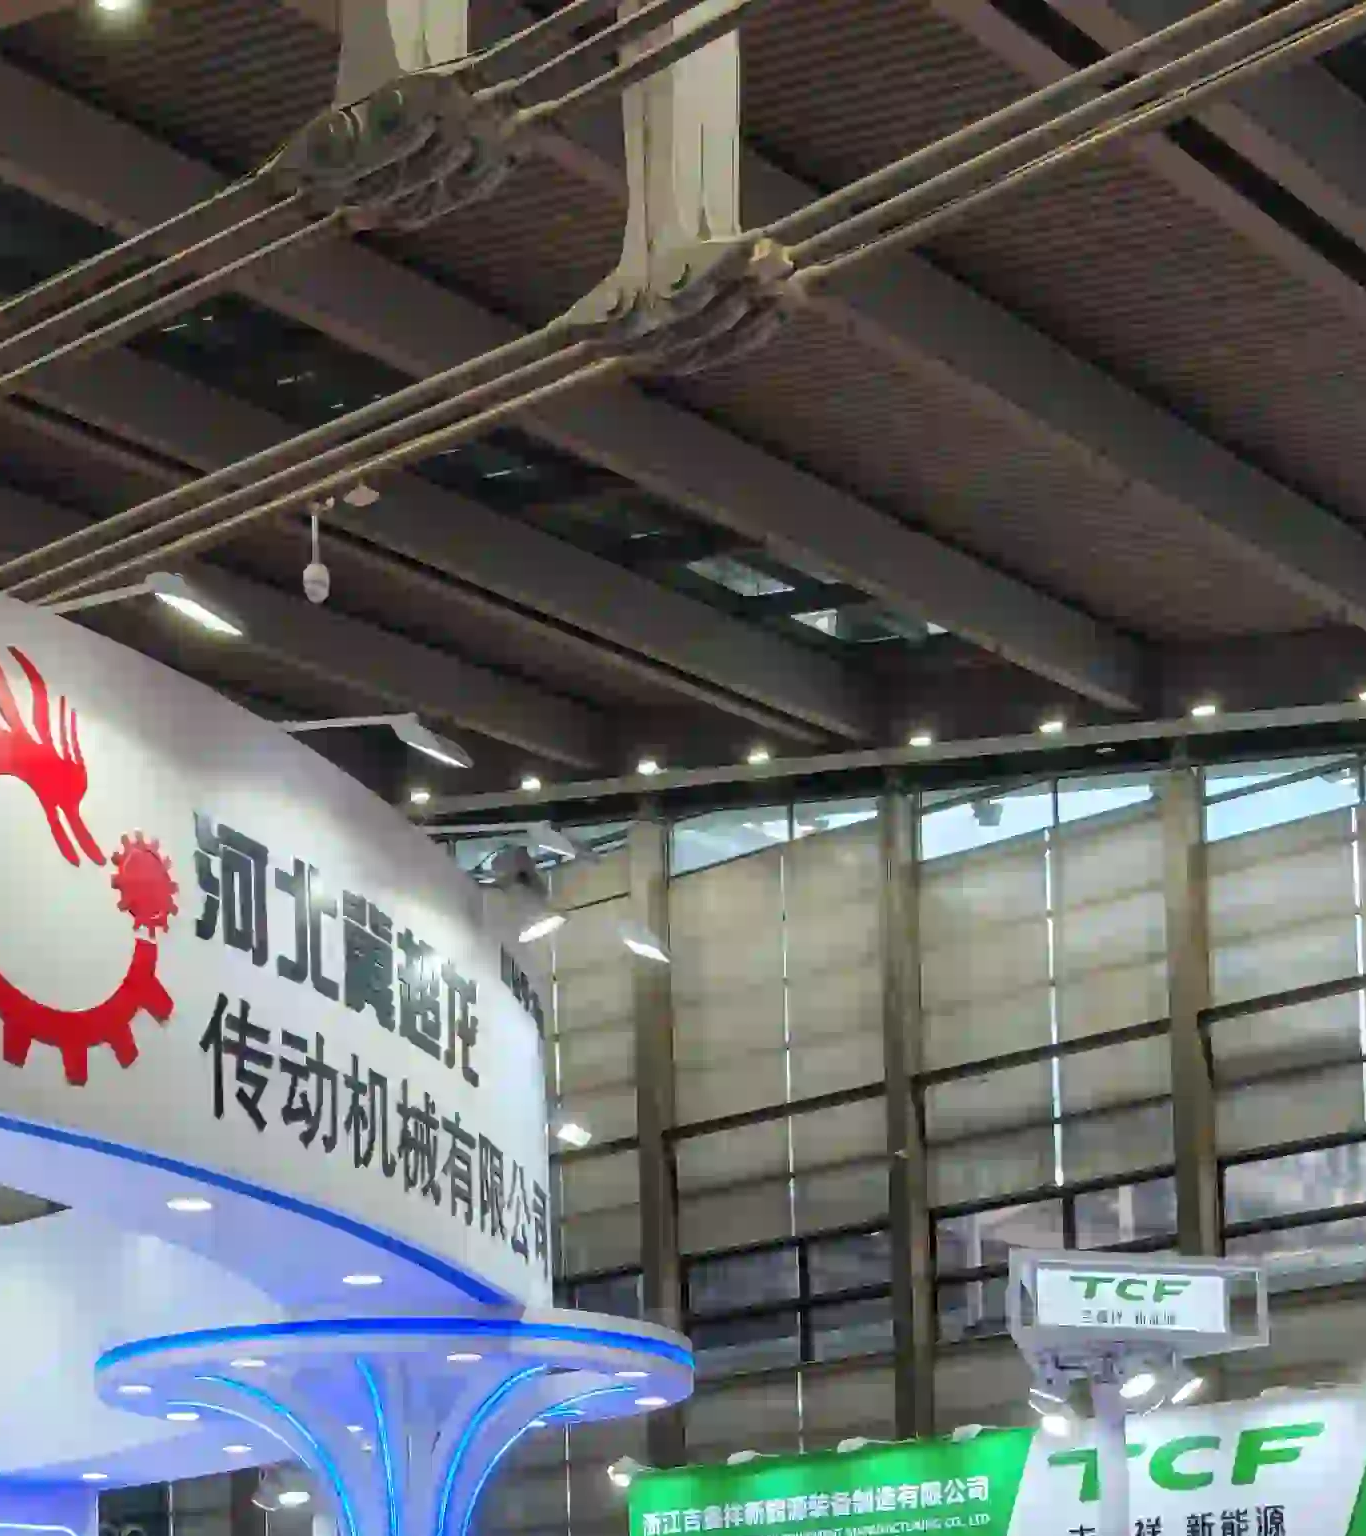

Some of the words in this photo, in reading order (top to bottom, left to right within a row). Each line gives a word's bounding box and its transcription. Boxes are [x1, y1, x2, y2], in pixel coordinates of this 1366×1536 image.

[193, 809, 480, 1087] 河北冀超龙
[199, 992, 552, 1282] 传动机械有限公司
[1069, 1274, 1192, 1303] TCF
[1046, 1421, 1326, 1503] TCF
